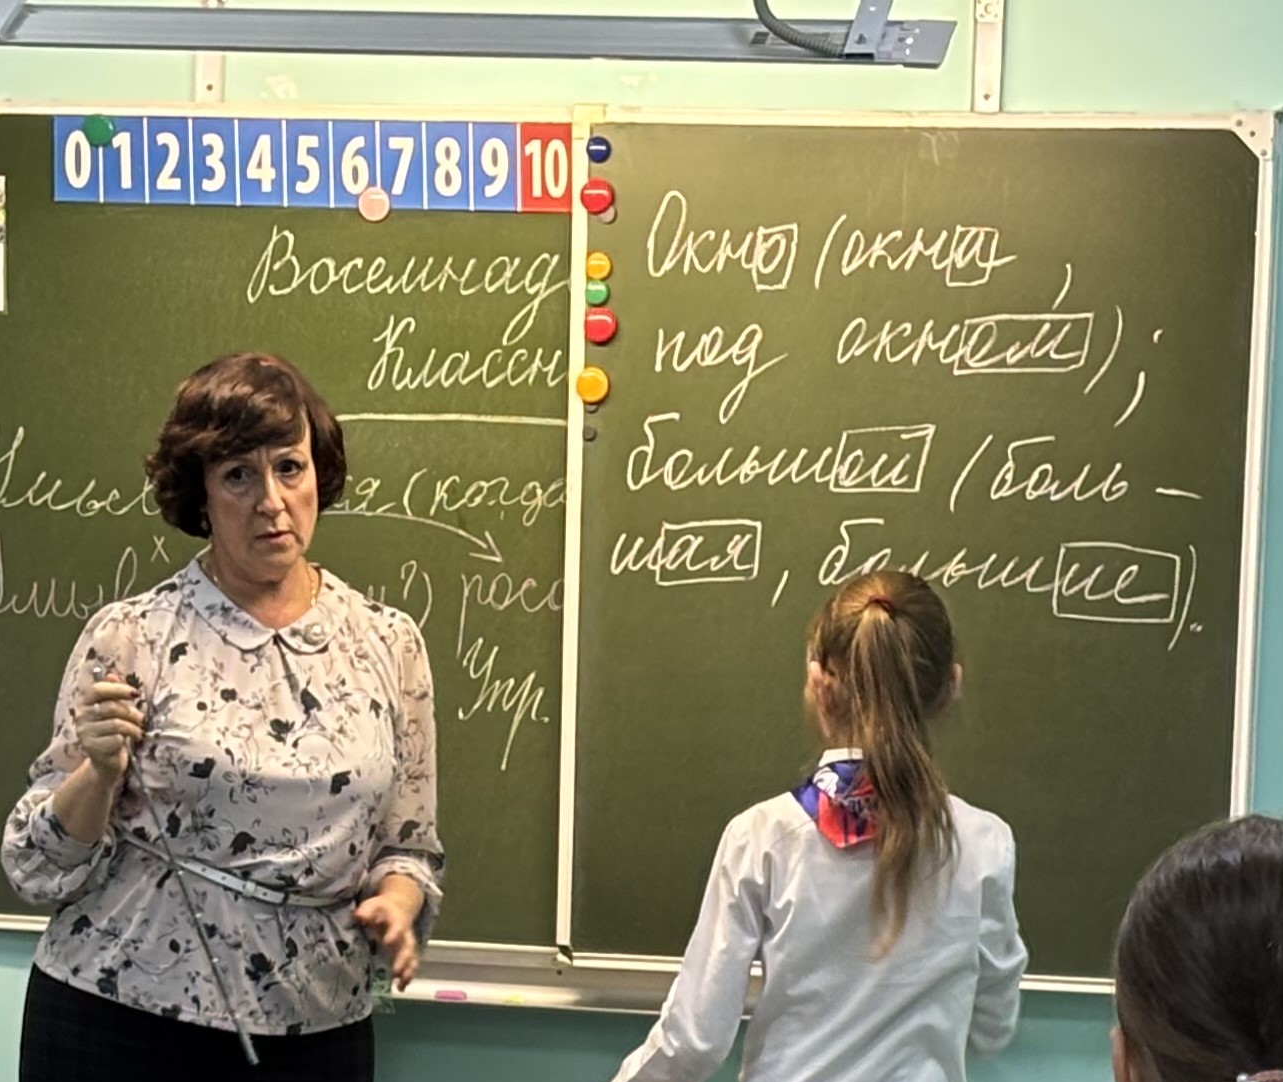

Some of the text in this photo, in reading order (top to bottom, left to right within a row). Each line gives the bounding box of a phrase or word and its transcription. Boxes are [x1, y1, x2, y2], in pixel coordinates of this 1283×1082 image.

[64, 130, 569, 199] 0 1 2 3 4 5 6 7 8 9 10
[646, 189, 797, 292] Окно
[654, 317, 789, 425] под
[625, 412, 937, 493] большой
